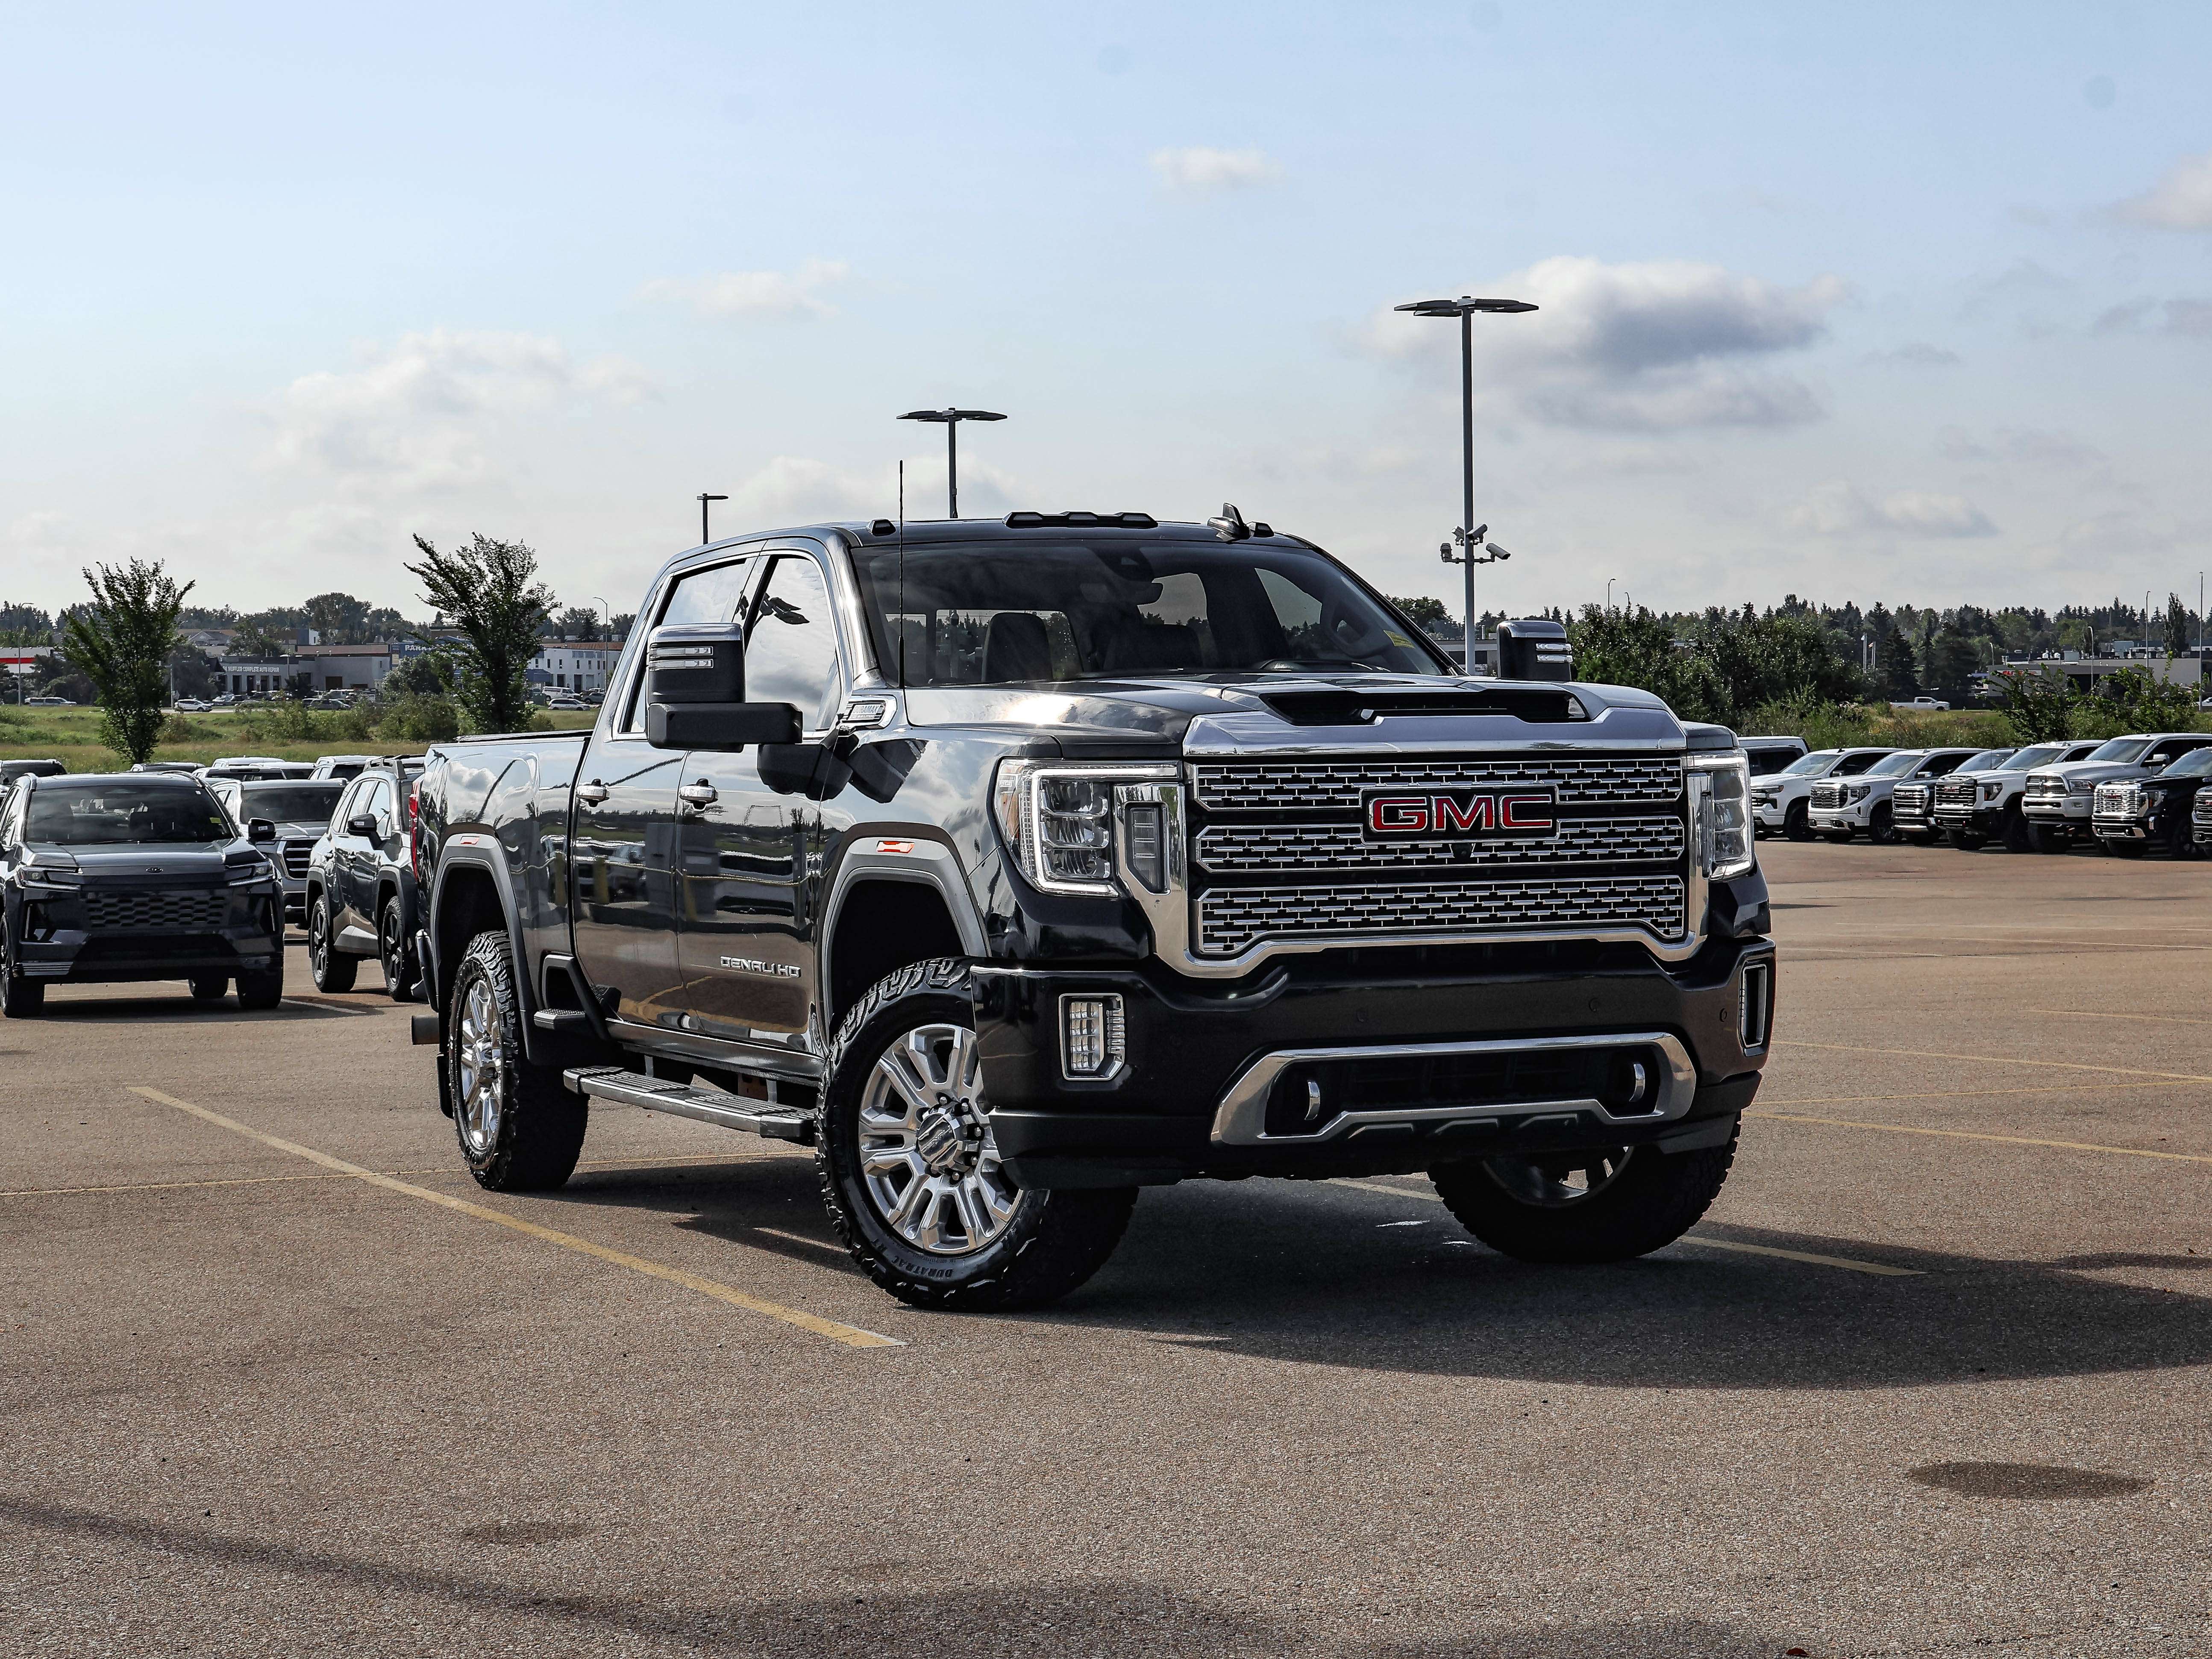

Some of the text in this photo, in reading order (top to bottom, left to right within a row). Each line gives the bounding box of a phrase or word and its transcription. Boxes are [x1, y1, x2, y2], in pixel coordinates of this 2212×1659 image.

[852, 705, 879, 714] DURAMAX
[1368, 794, 1552, 832] GMC
[720, 956, 801, 978] DENALI HD
[891, 1255, 954, 1278] DURATRAC
